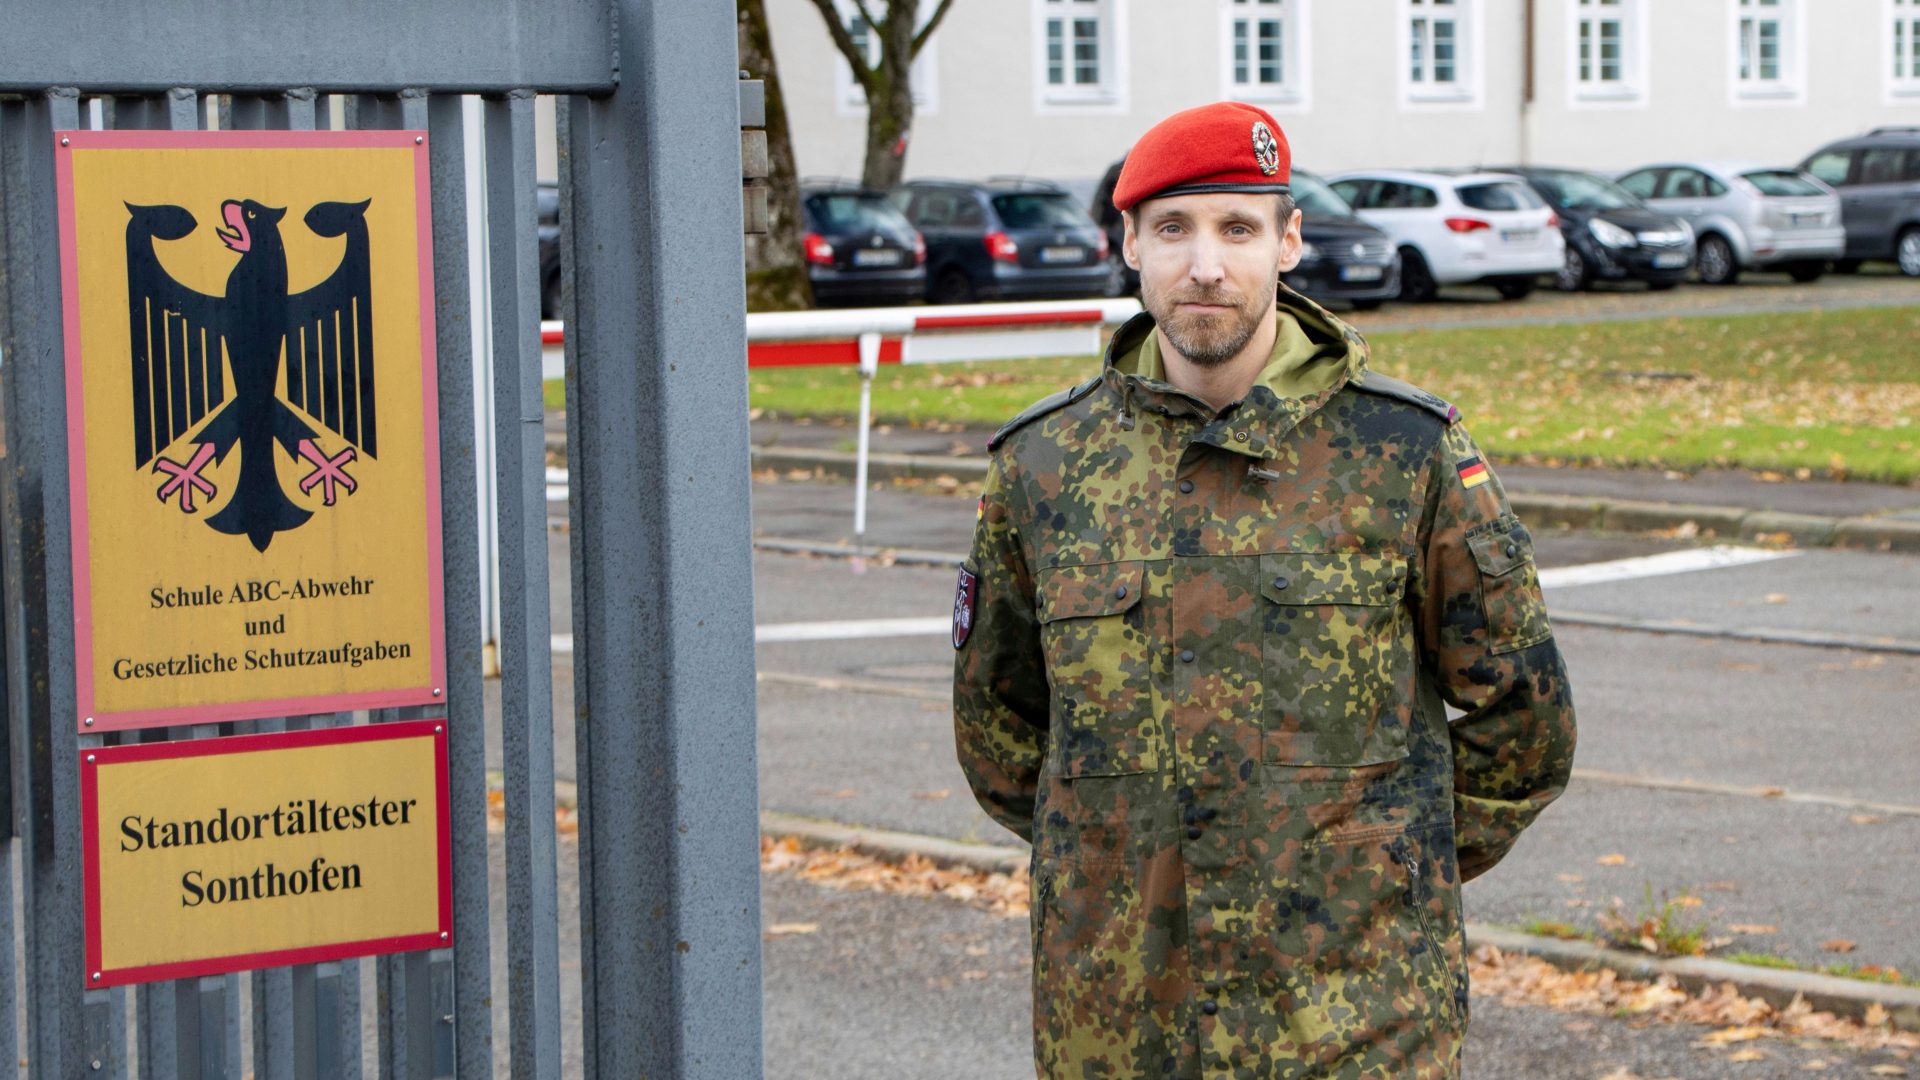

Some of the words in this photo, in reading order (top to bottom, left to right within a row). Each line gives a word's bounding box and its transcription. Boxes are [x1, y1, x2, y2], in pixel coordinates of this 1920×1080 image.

[150, 585, 223, 608] Schule
[229, 575, 374, 603] ABC-Abwehr
[244, 614, 285, 636] und
[113, 653, 238, 680] Gesetzliche
[244, 641, 411, 670] Schutzaufgaben
[120, 796, 417, 852] Standortältester
[181, 857, 362, 907] Sonthofen
